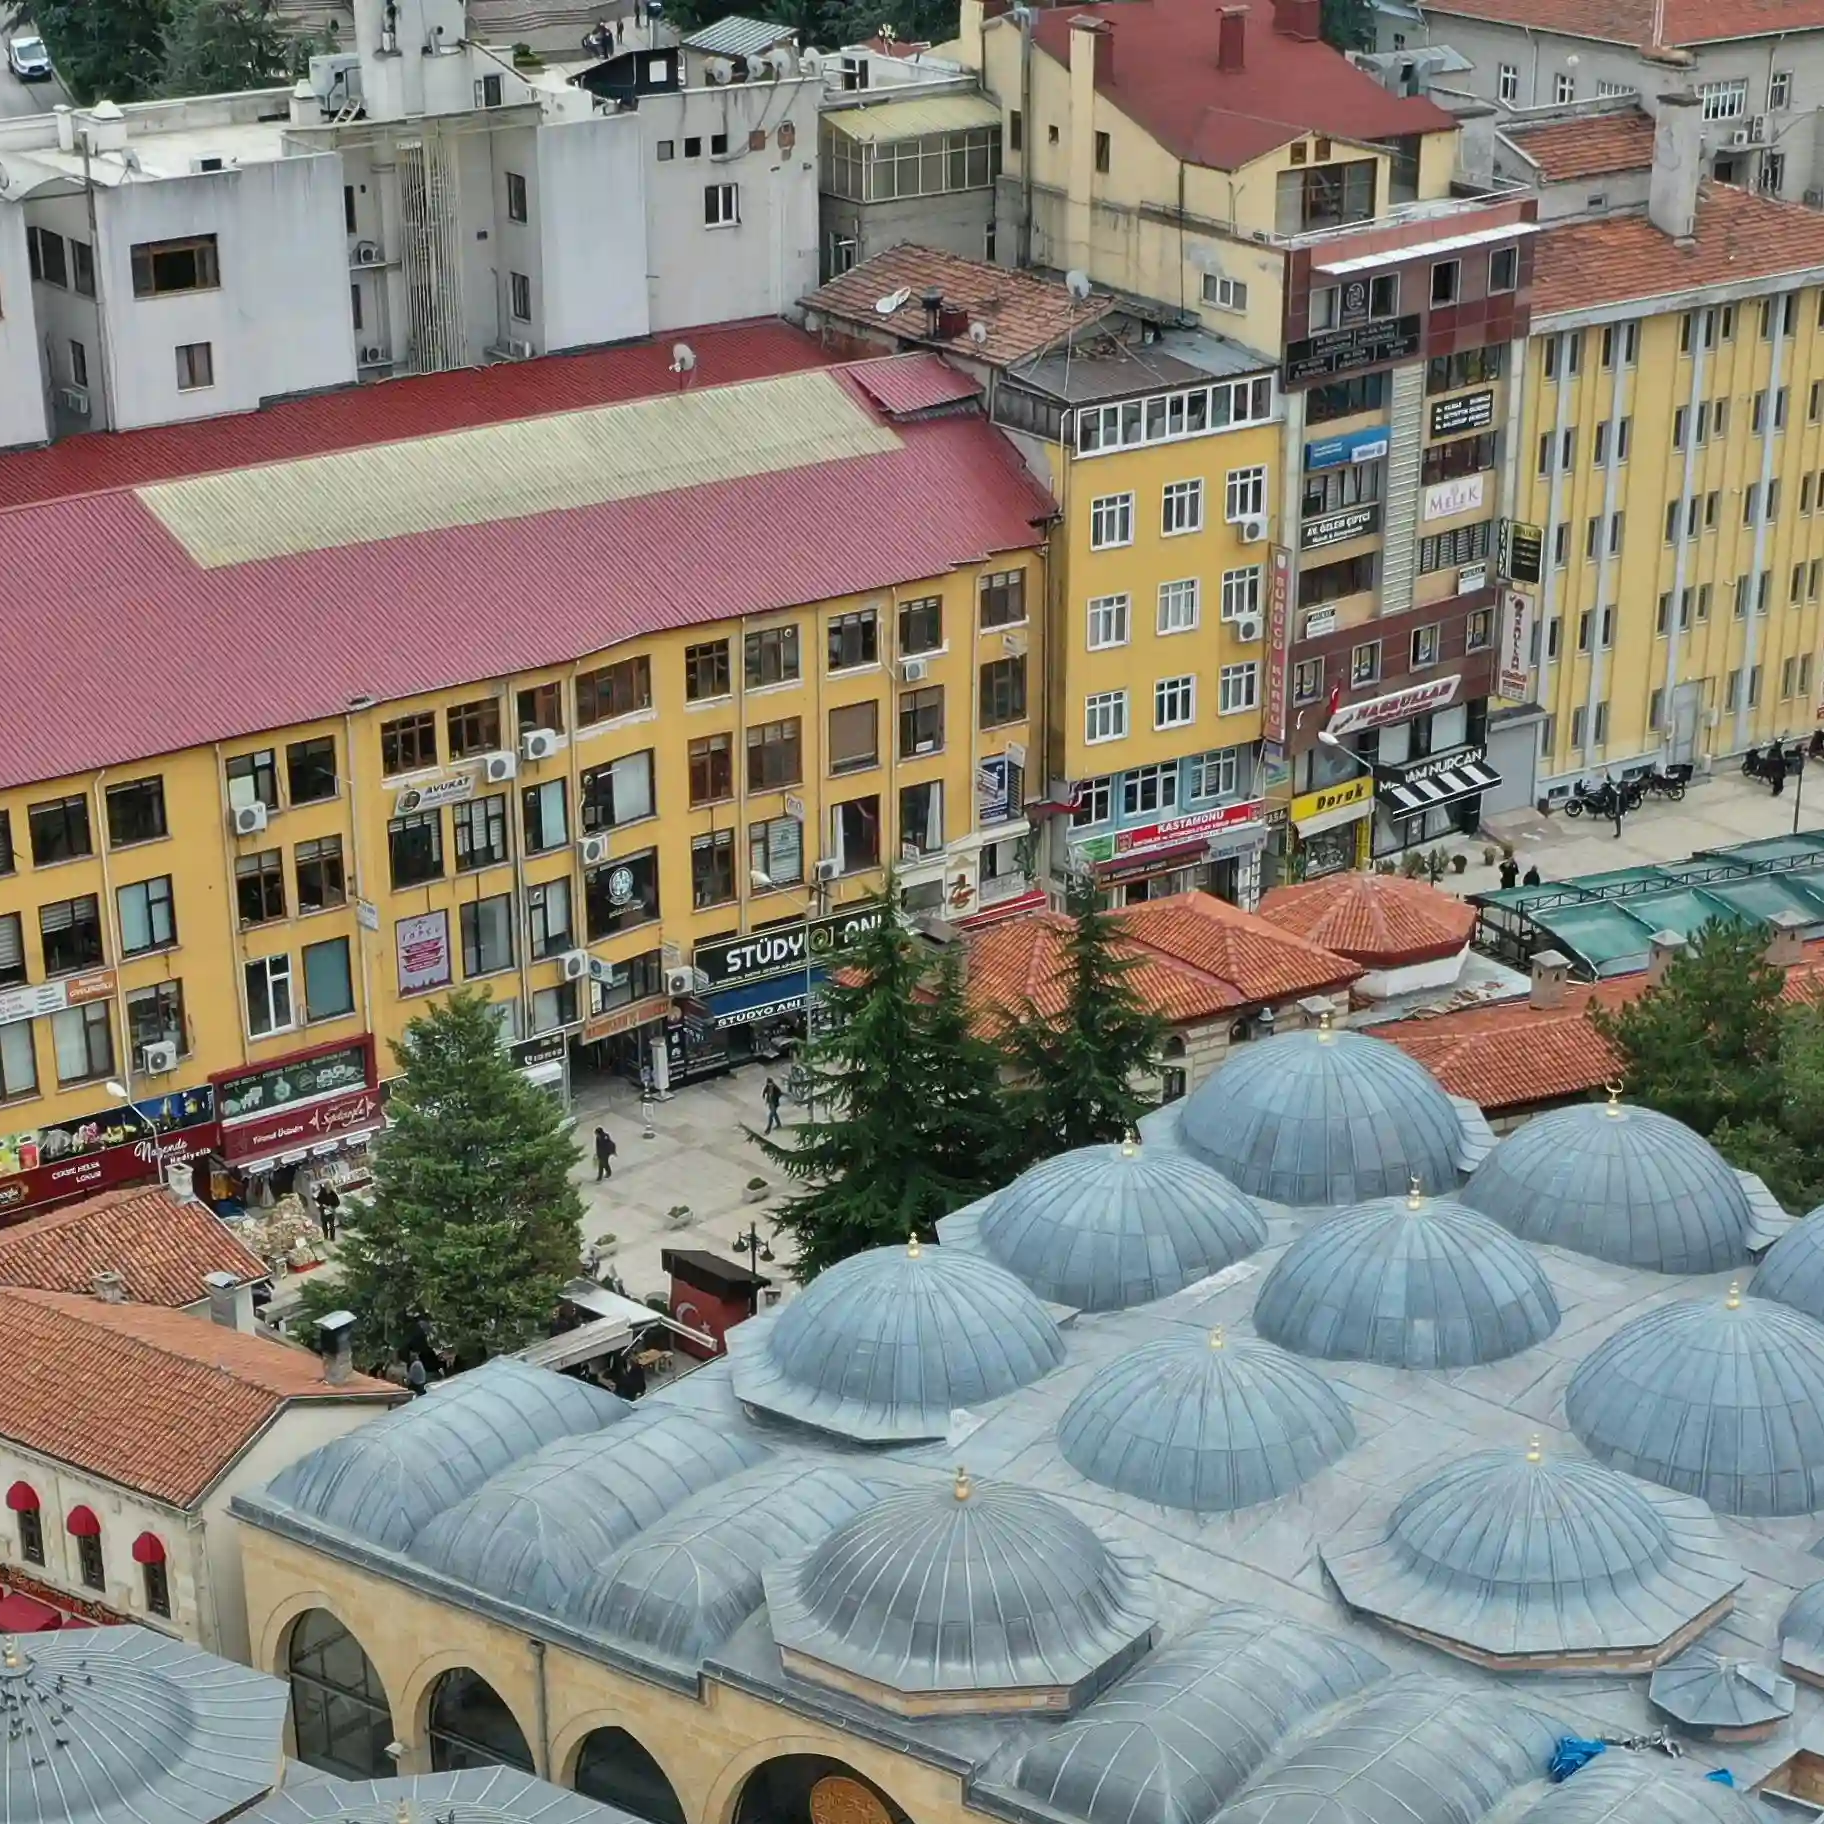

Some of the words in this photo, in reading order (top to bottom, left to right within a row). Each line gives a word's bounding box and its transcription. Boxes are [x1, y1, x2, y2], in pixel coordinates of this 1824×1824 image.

[1429, 749, 1483, 778] NURCAN
[1316, 783, 1365, 811] Doruk
[1157, 809, 1225, 835] KASTAMONU
